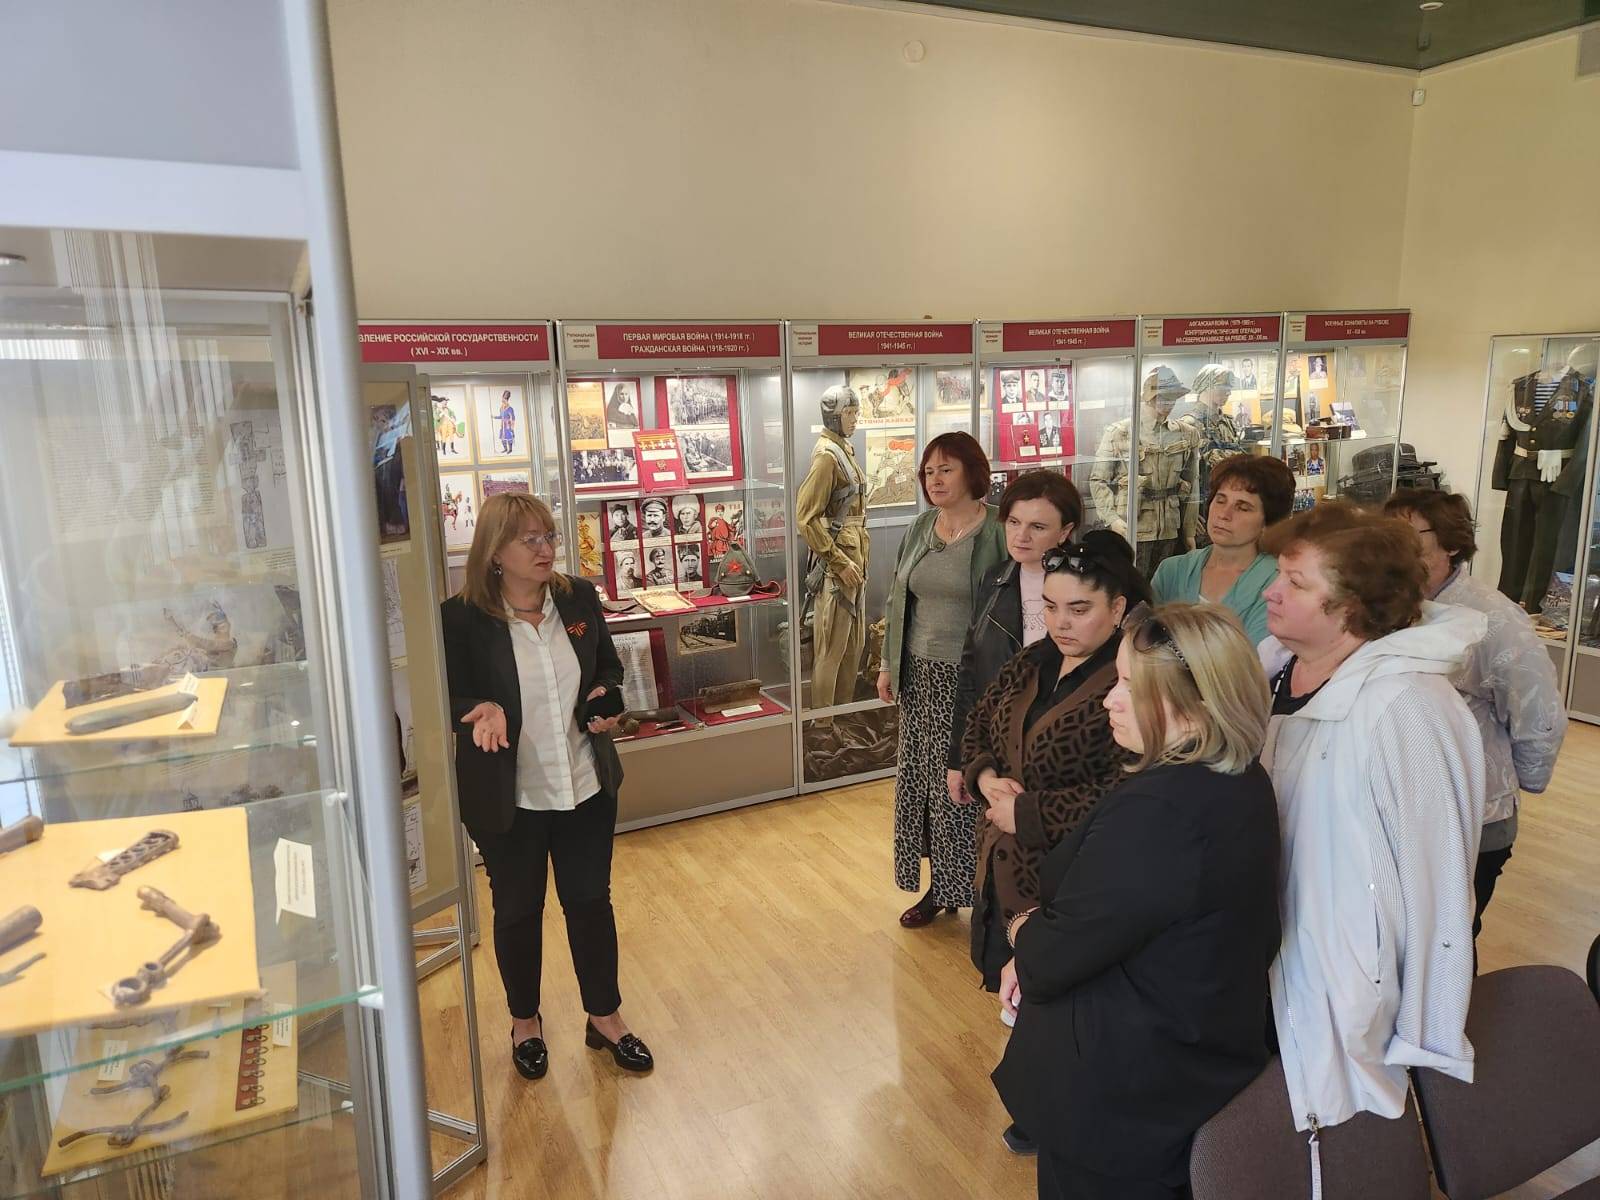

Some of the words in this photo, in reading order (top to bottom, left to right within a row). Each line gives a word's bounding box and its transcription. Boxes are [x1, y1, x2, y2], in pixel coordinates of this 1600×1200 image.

[623, 332, 651, 341] ПЕРВАЯ
[652, 332, 686, 341] МИРОВАЯ
[686, 331, 710, 341] ВОЙНА
[848, 331, 875, 339] ВЕЛИКАЯ
[876, 331, 923, 339] ОТЕЧЕСТВЕННАЯ
[924, 329, 944, 339] ВОЙНА
[1029, 328, 1051, 336] ВЕЛИКАЯ
[1052, 327, 1093, 335] ОТЕЧЕСТВЕННАЯ
[1093, 326, 1110, 334] ВОЙНА
[394, 332, 450, 343] РОССИЙСКОЙ
[451, 332, 539, 343] ГОСУДАРСТВЕННОСТИ
[415, 347, 429, 356] XVI
[436, 346, 450, 355] XIX
[630, 345, 681, 354] ГРАЖДАНСКАЯ
[682, 343, 706, 353] ВОЙНА
